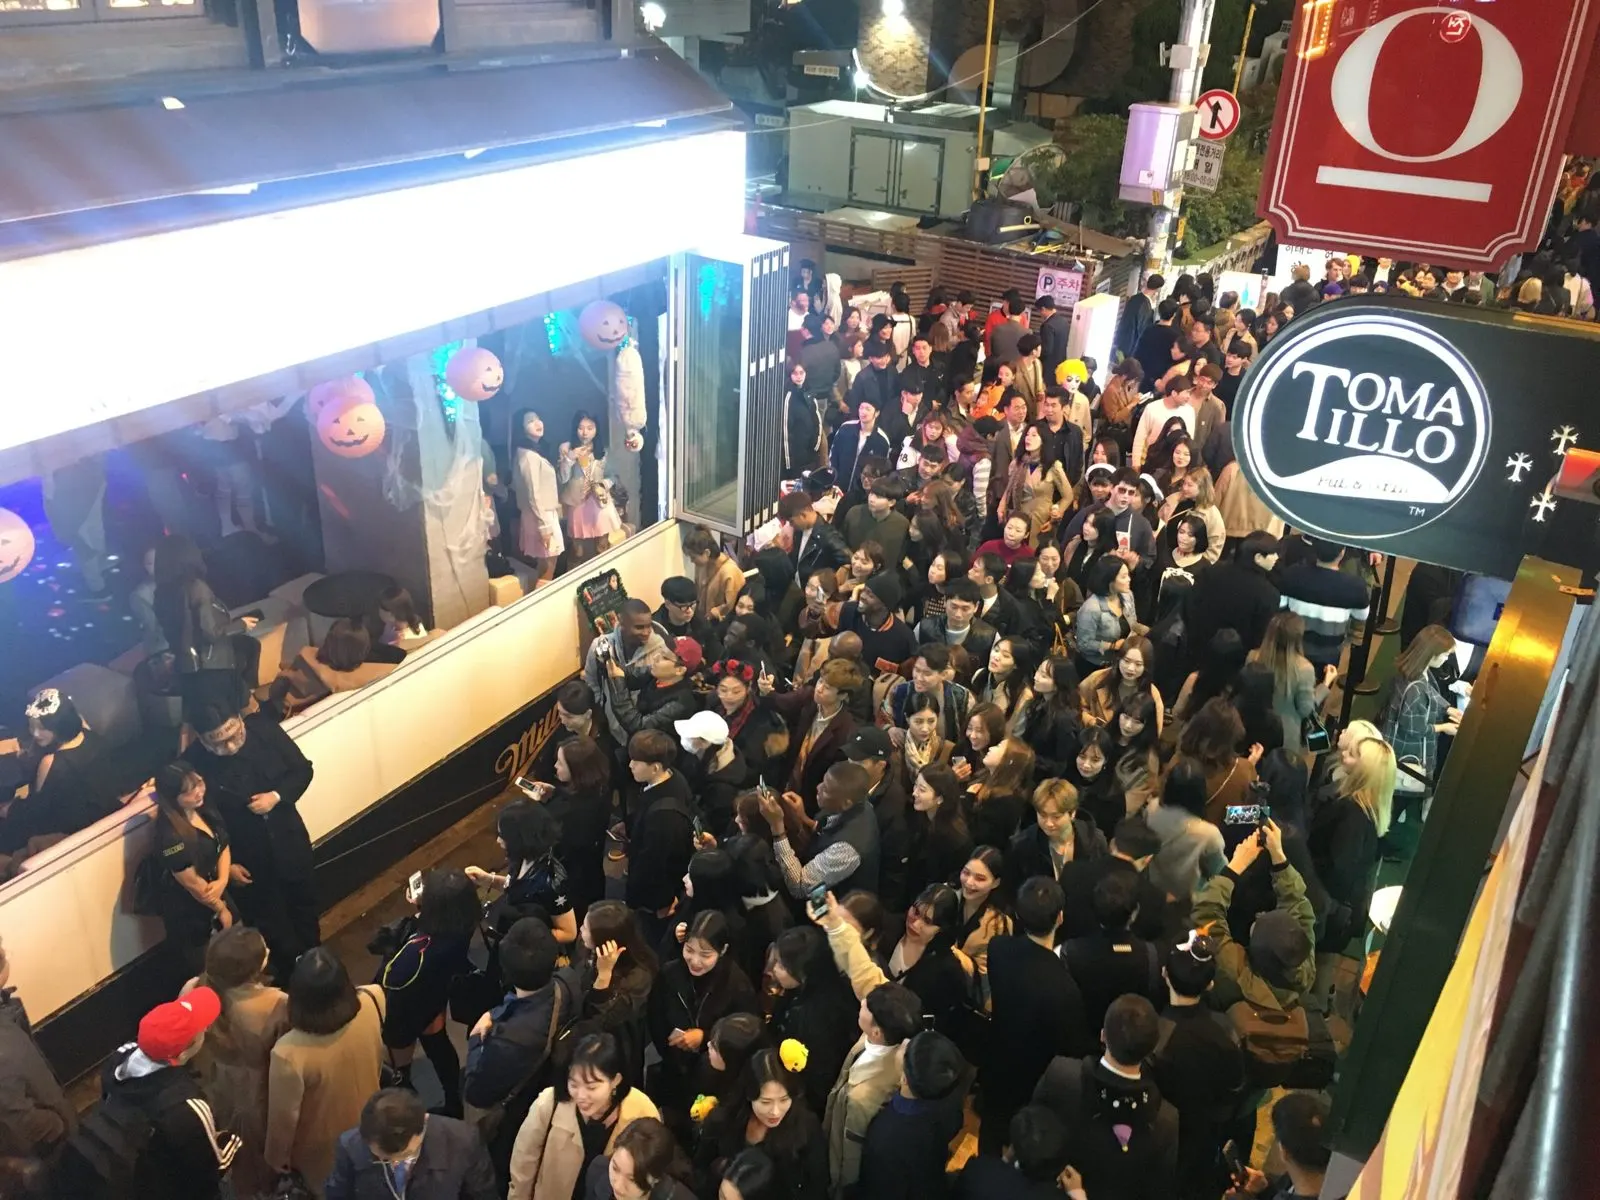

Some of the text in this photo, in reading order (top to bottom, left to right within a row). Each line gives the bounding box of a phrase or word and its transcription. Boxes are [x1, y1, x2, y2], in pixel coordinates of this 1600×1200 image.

[1330, 5, 1524, 163] O
[1057, 278, 1079, 291] 주차
[1409, 506, 1425, 516] TM
